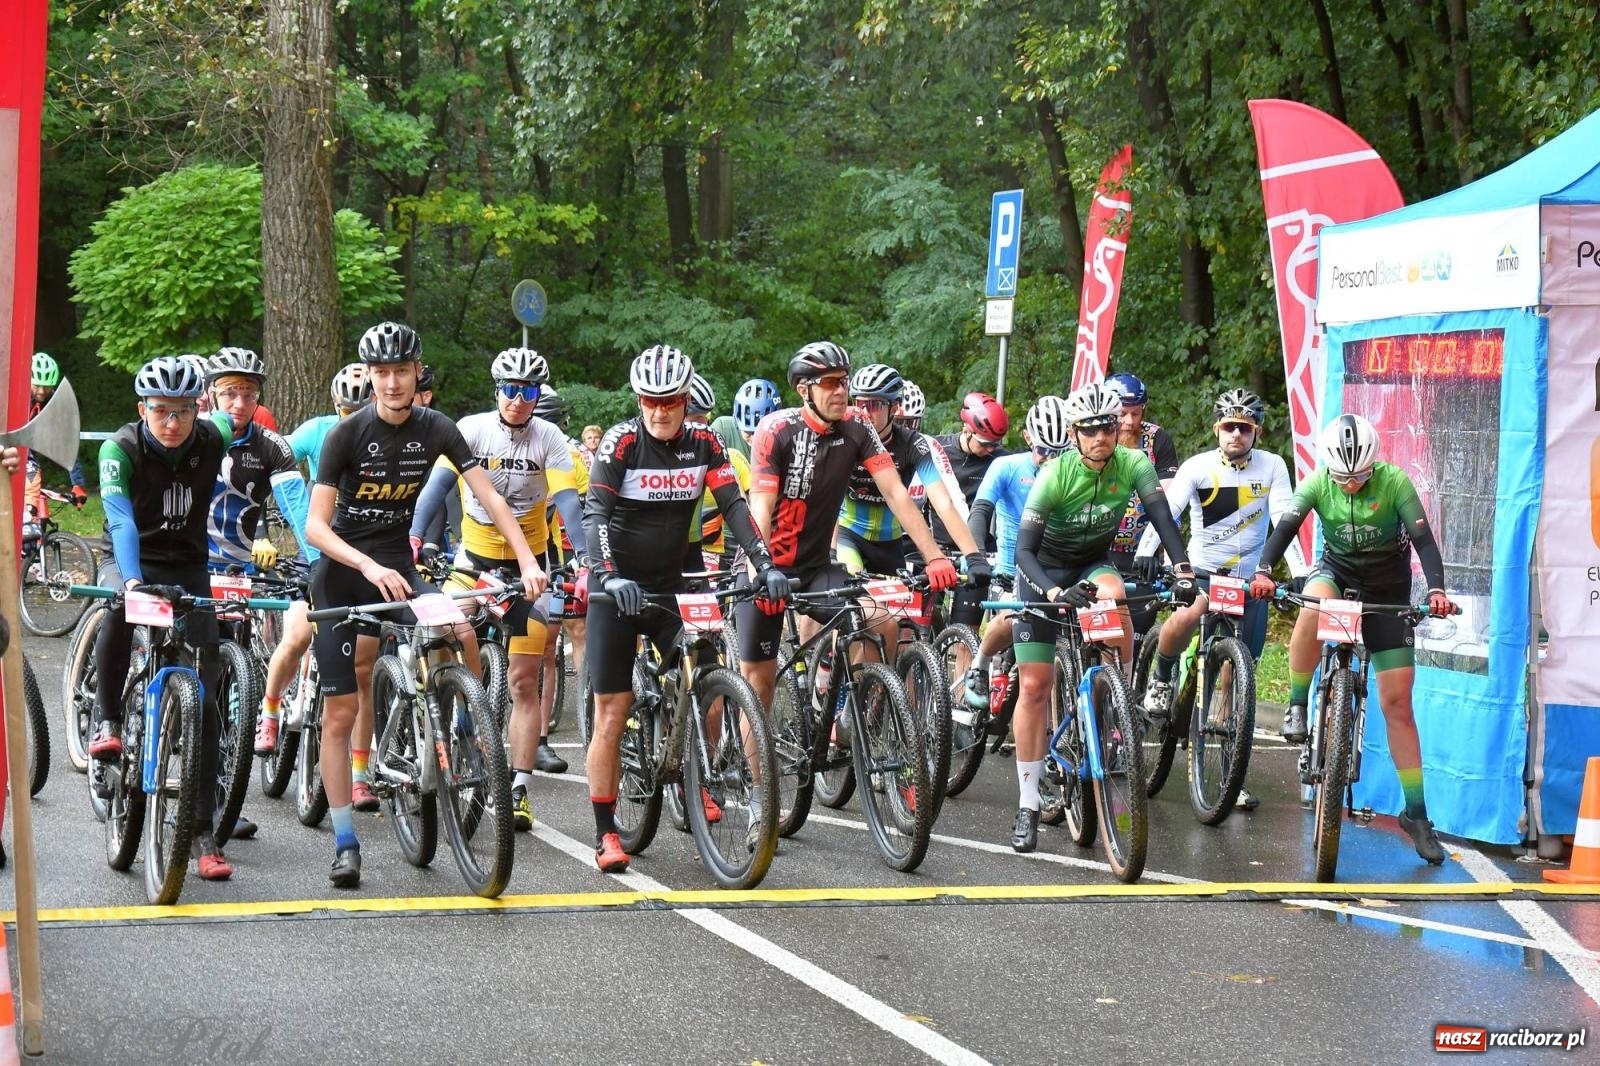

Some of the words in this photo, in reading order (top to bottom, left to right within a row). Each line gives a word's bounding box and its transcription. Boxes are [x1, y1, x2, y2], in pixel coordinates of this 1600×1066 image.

[994, 201, 1015, 266] P
[1496, 256, 1519, 272] MITKO
[640, 470, 698, 490] SOKÓŁ
[355, 482, 419, 500] RMF
[648, 490, 693, 500] ROWERY
[1216, 588, 1238, 601] 30
[688, 606, 711, 618] 22
[1091, 613, 1109, 626] 31
